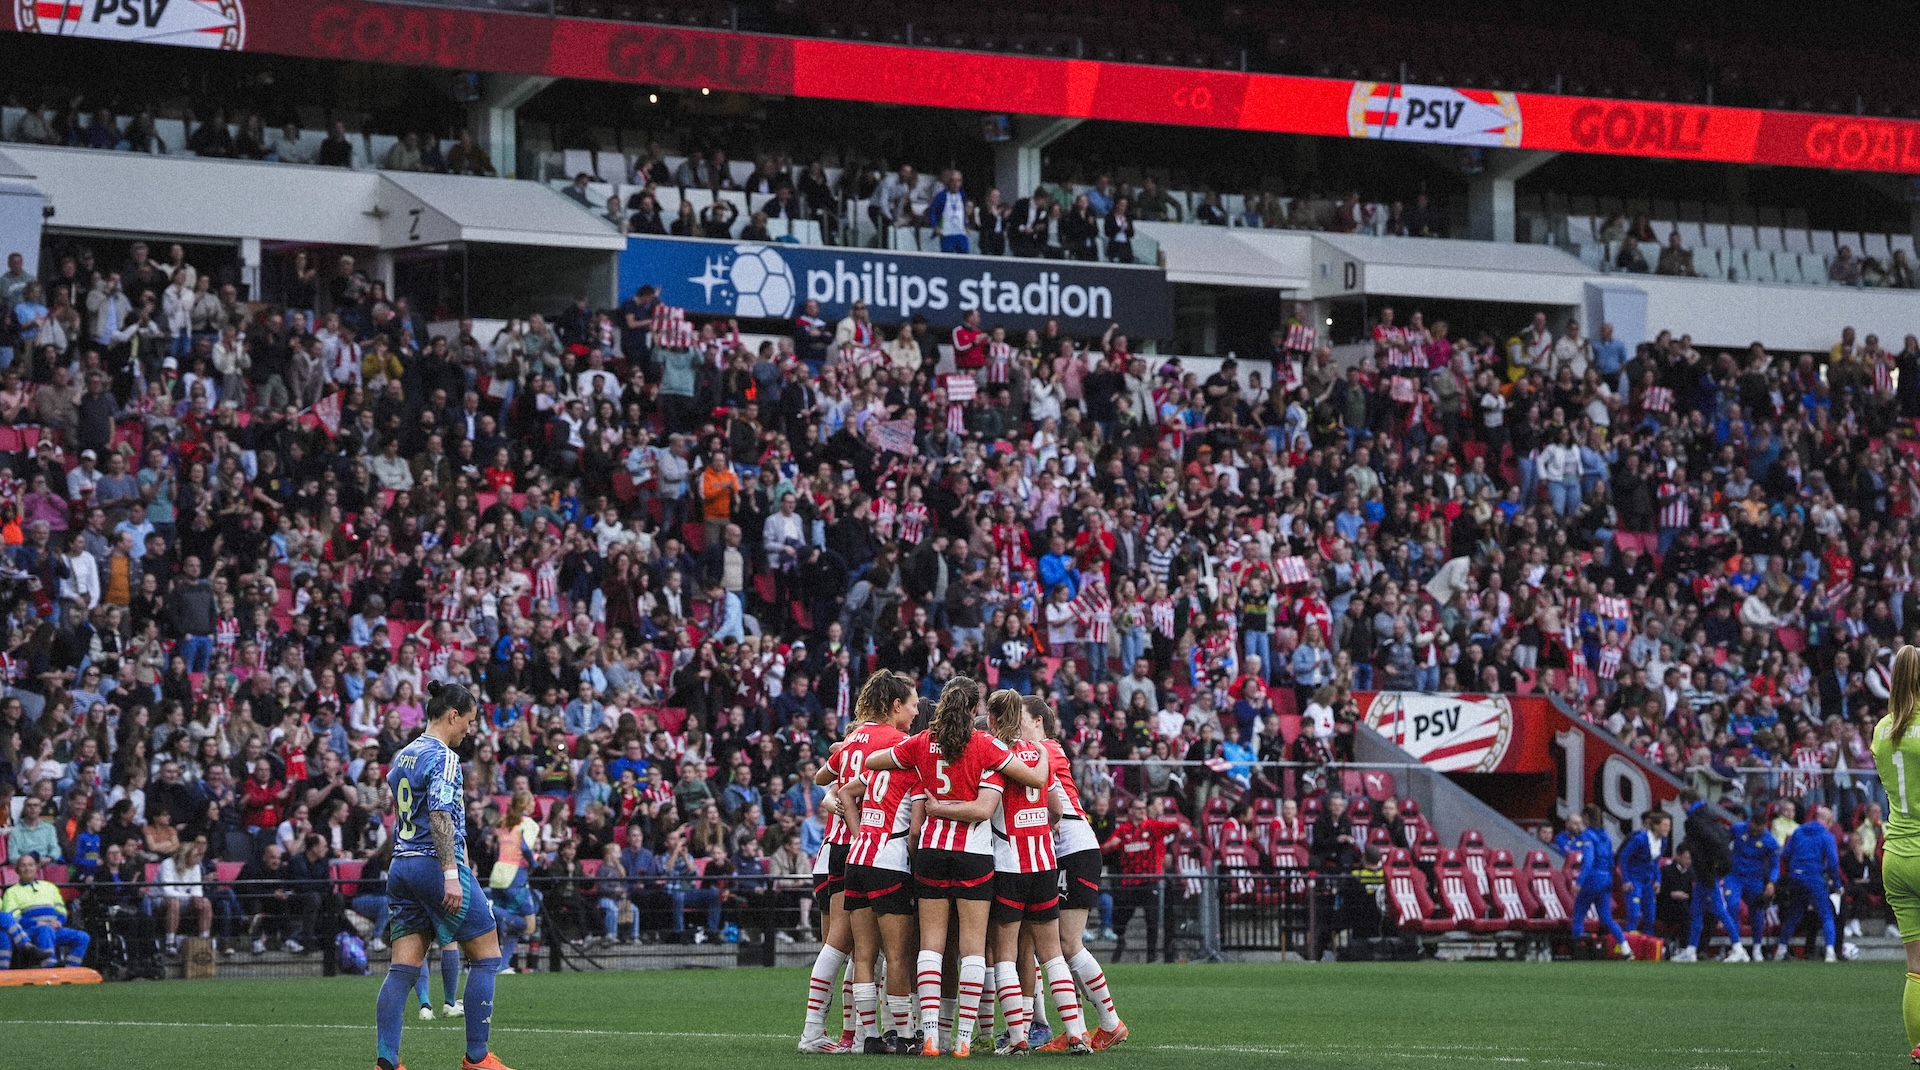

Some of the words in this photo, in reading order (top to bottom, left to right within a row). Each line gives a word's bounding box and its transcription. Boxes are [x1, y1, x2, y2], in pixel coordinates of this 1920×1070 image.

[91, 0, 168, 28] PSV
[1406, 98, 1465, 129] PSV
[1571, 104, 1710, 151] GOAL!
[806, 260, 949, 317] philips
[959, 271, 1112, 319] stadion
[1344, 261, 1356, 290] D
[1413, 705, 1460, 741] PSV
[936, 759, 951, 795] 5
[1892, 751, 1908, 813] 1
[397, 777, 416, 841] 8
[1057, 869, 1067, 891] 4
